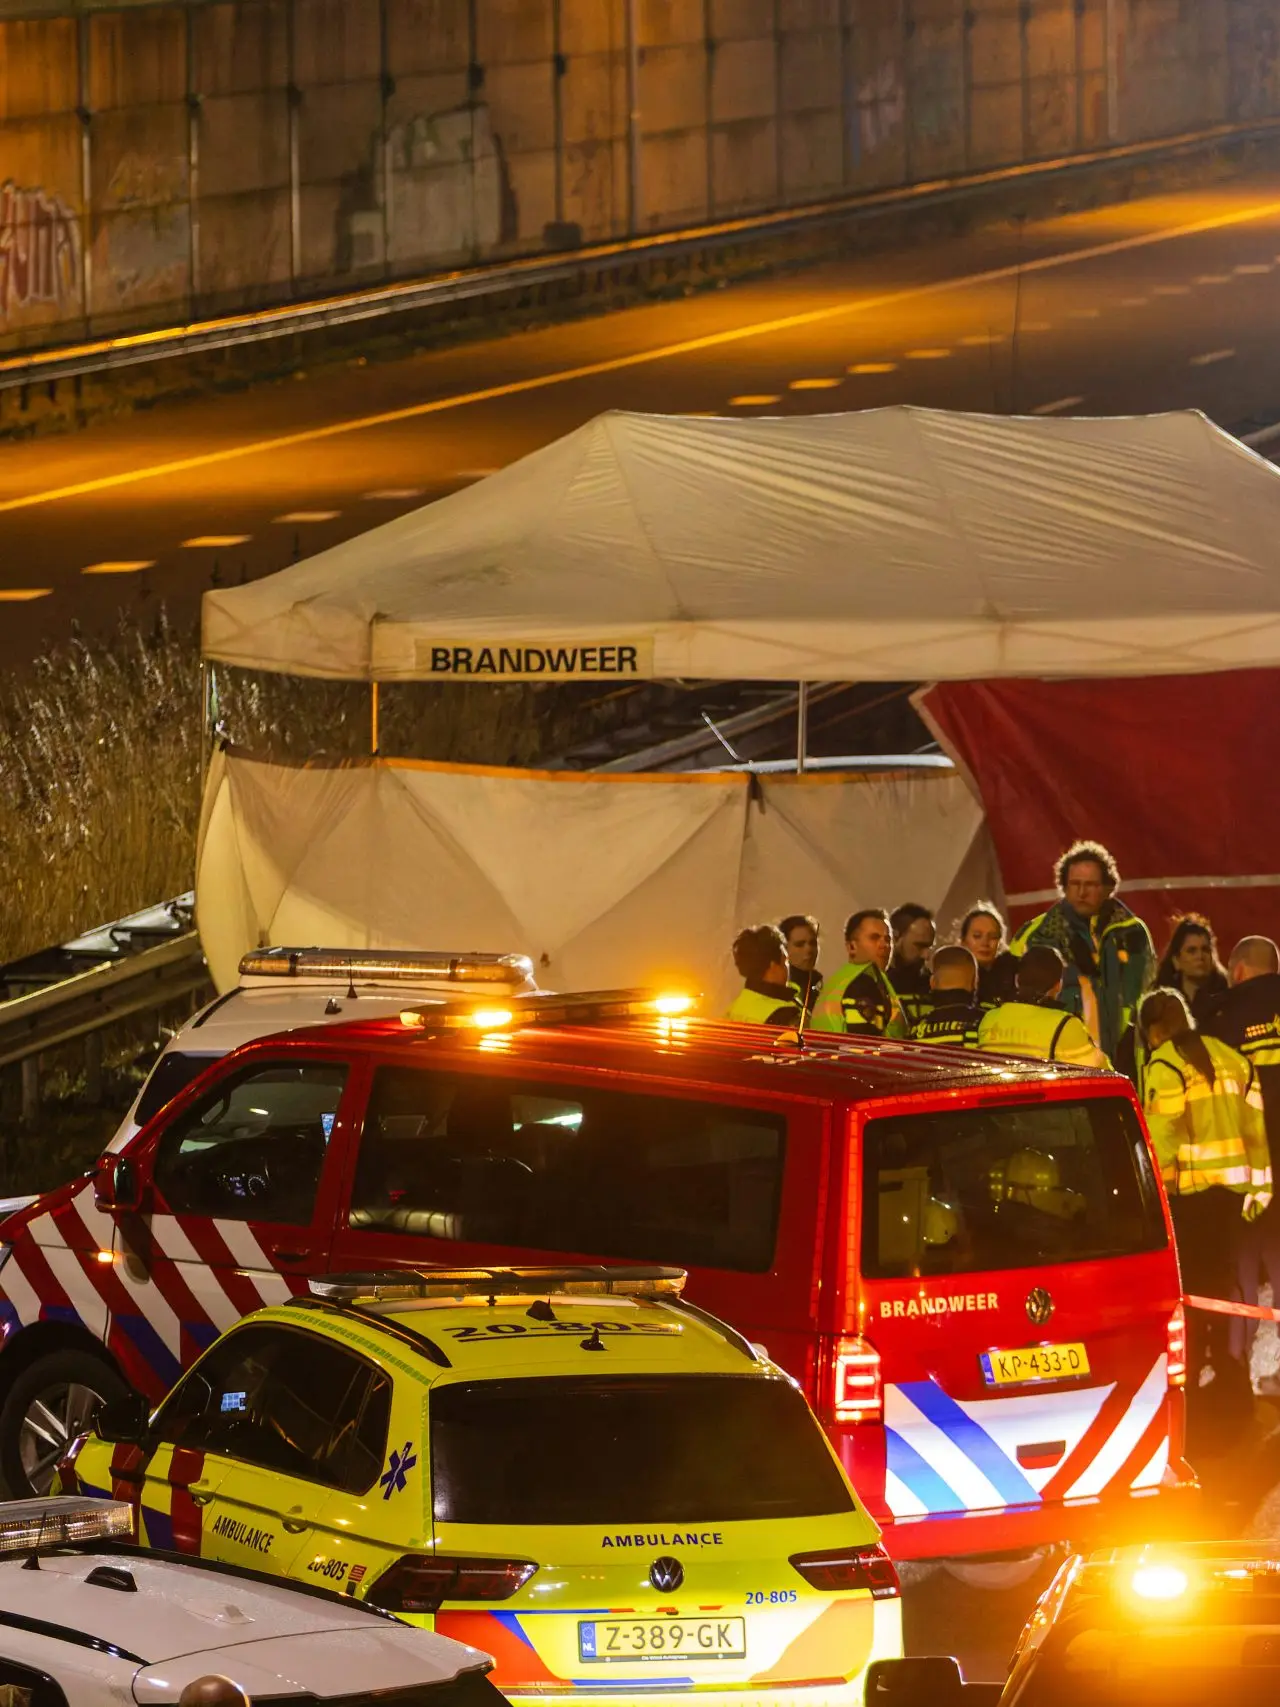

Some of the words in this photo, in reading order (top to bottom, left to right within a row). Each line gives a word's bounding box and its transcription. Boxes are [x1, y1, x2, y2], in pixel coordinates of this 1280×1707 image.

[431, 646, 637, 673] BRANDWEER
[880, 1293, 999, 1318] BRANDWEER
[442, 1321, 682, 1339] 20-805
[998, 1348, 1080, 1378] KP-433-D
[211, 1515, 275, 1554] AMBULANCE
[601, 1532, 724, 1548] AMBULANCE
[745, 1590, 797, 1605] 20-805
[583, 1642, 595, 1652] NL
[605, 1623, 733, 1651] Z-389-GK
